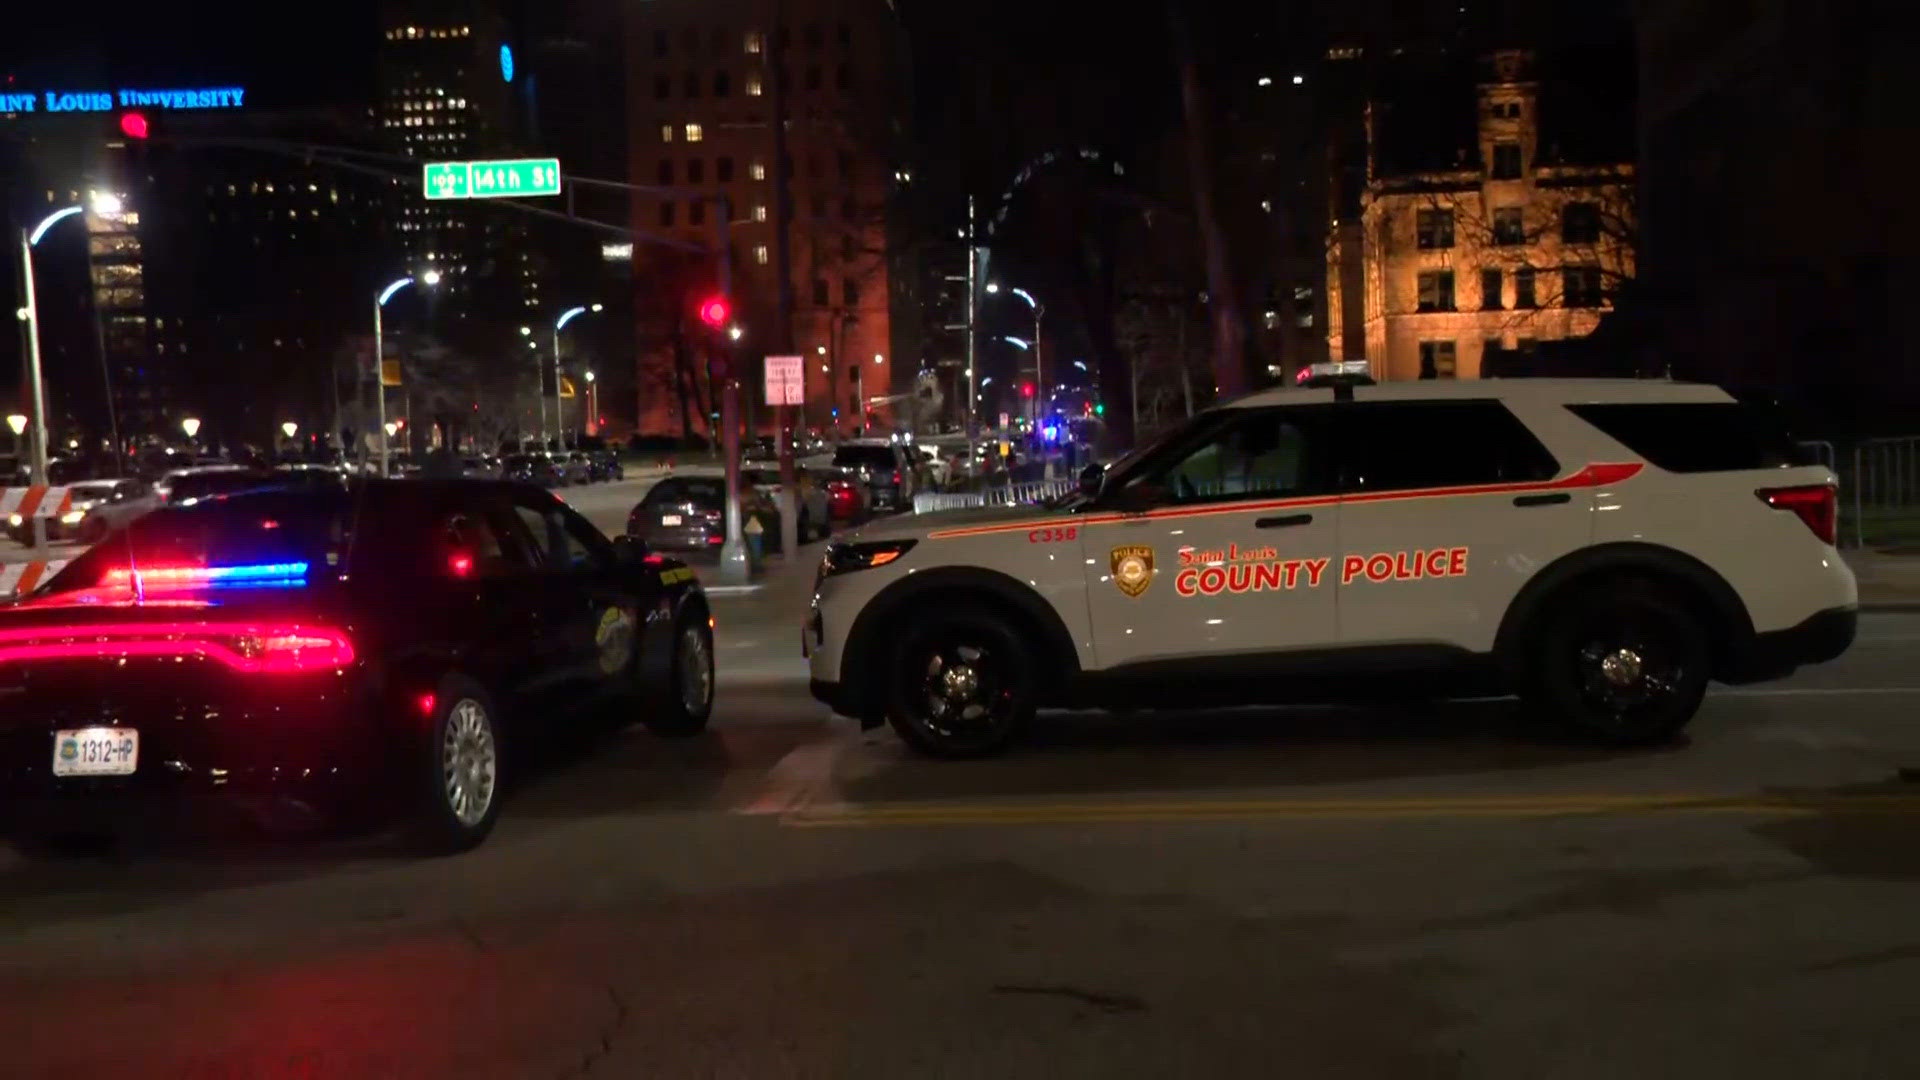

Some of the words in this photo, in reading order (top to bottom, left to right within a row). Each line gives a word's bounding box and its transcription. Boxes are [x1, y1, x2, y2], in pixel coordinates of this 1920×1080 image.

[46, 92, 112, 112] LOUIS
[119, 88, 244, 108] UNIVERSITY
[474, 168, 521, 190] 14th
[532, 165, 555, 187] St
[1175, 557, 1330, 596] COUNTY
[1342, 547, 1468, 584] POLICE
[82, 739, 133, 762] 1312-HP
